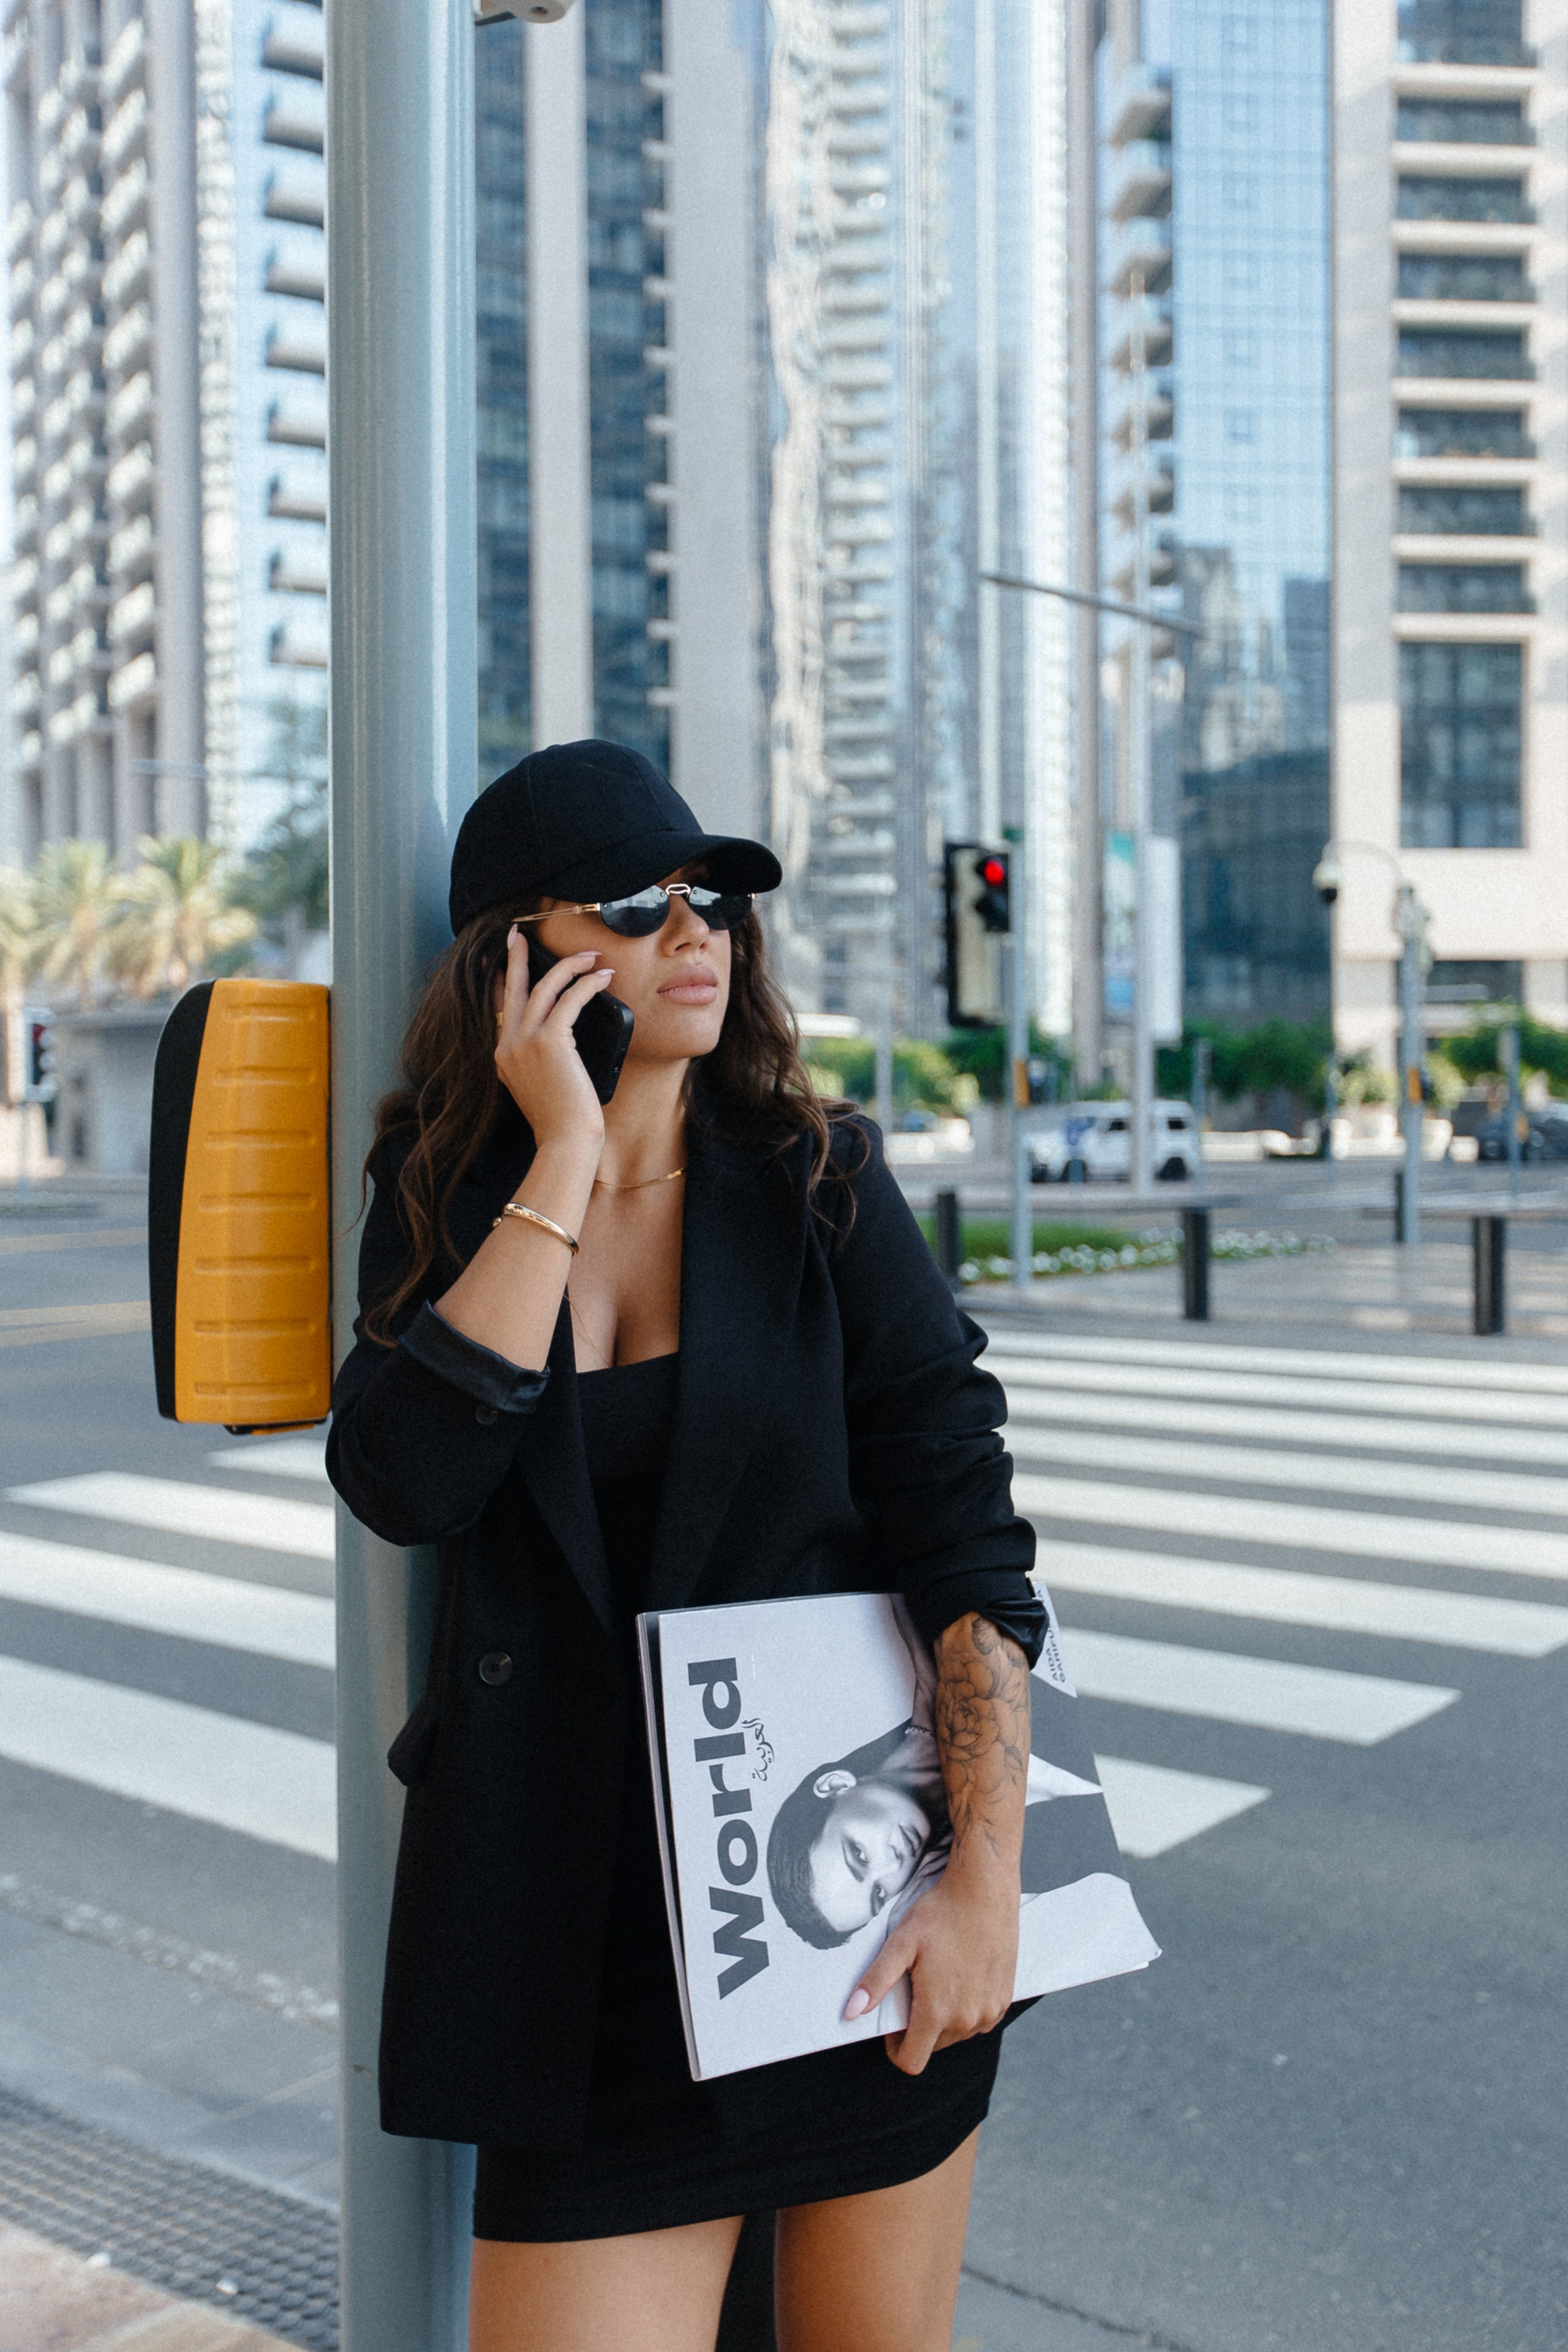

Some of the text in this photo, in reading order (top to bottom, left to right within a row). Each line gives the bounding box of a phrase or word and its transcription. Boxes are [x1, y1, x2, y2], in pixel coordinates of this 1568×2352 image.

[1046, 1648, 1058, 1681] AIDA
[741, 1717, 774, 1781] العربية
[688, 1657, 769, 2000] World
